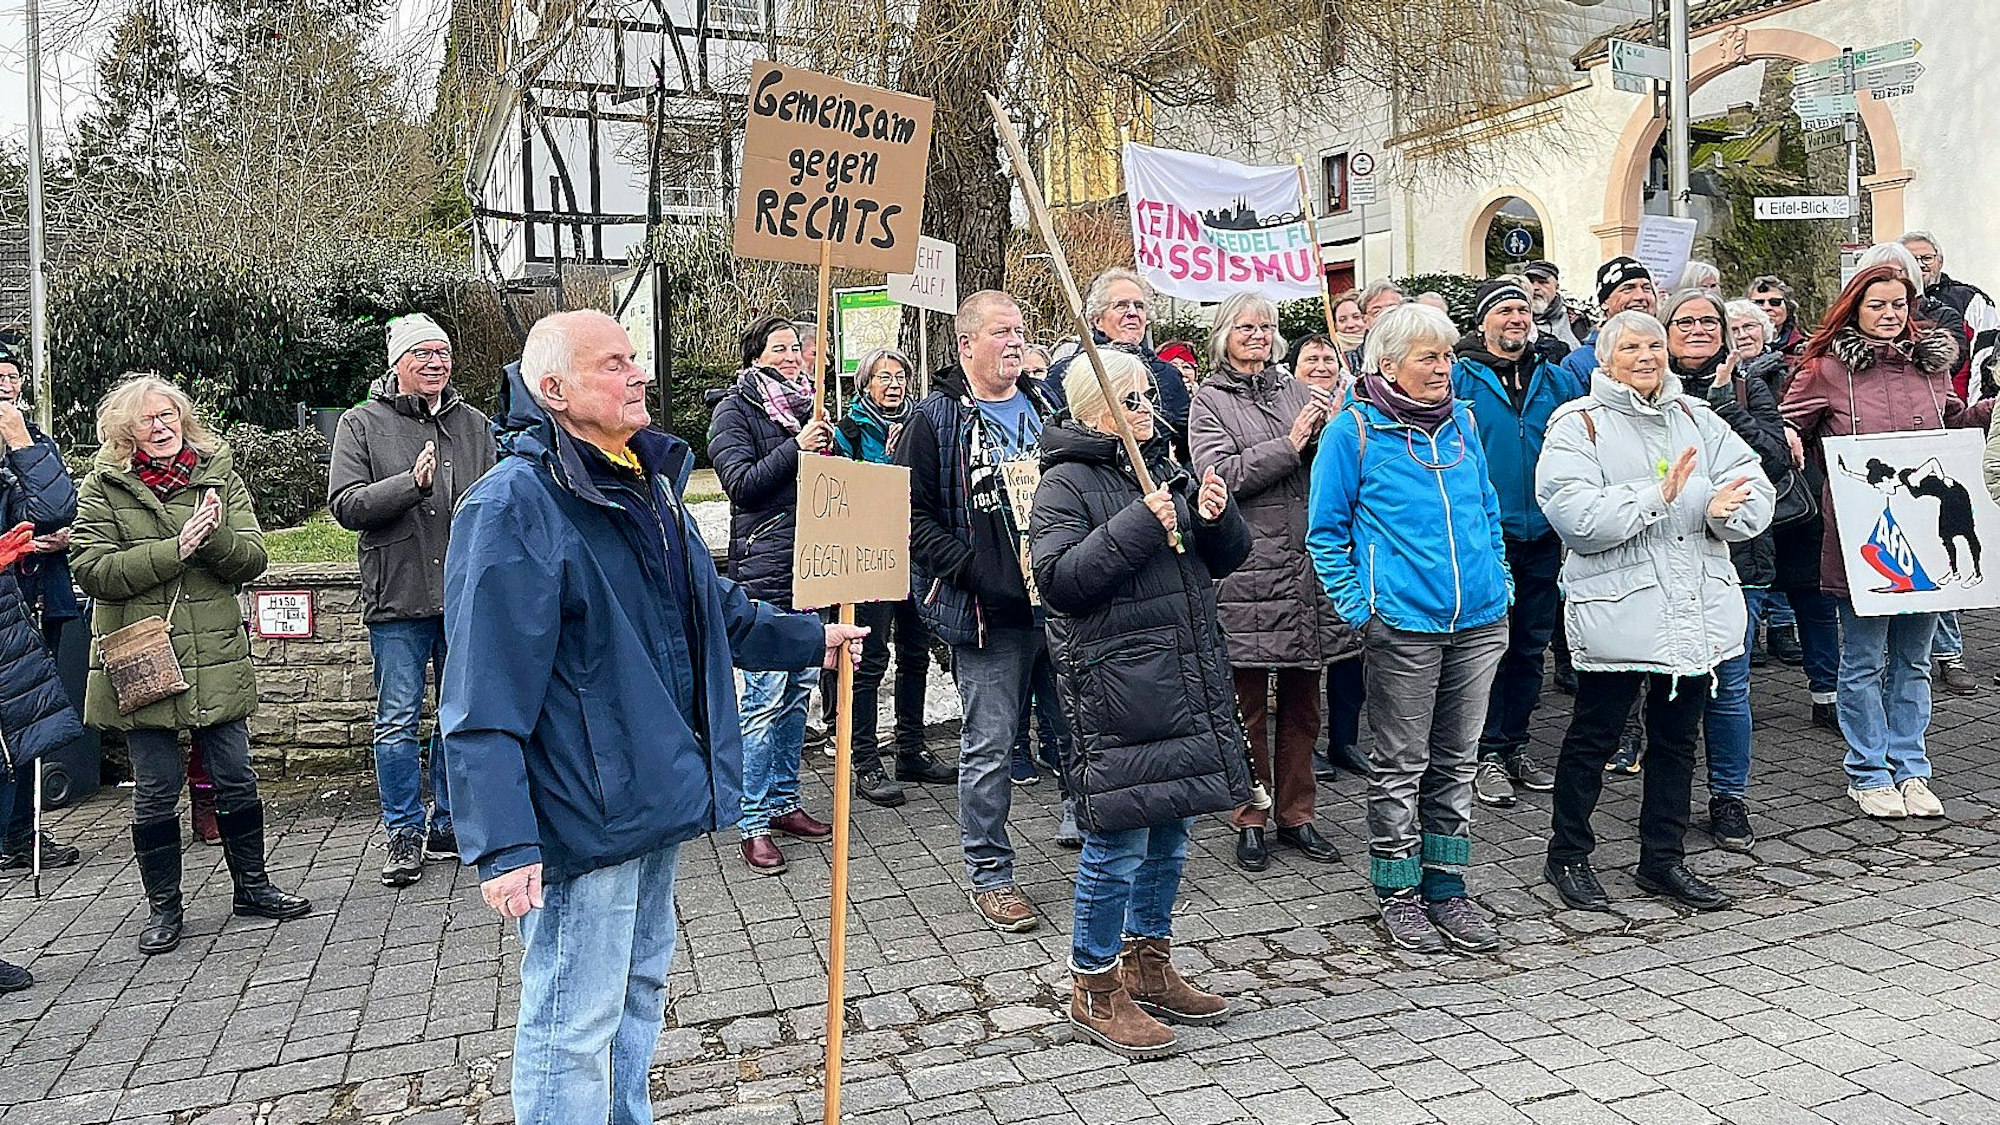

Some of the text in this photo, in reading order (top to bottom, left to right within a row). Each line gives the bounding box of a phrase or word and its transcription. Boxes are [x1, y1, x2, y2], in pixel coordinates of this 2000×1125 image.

[754, 70, 916, 144] Gemeinsam
[1807, 132, 1841, 148] Vorburg
[789, 149, 878, 193] gegen
[754, 189, 902, 249] RECHTS
[1770, 201, 1829, 215] Eifel-Blick
[918, 246, 942, 270] EHT
[909, 274, 945, 297] AUF!
[1006, 466, 1035, 487] Keine
[812, 472, 850, 518] OPA
[799, 544, 896, 580] GEGEN RECHTS
